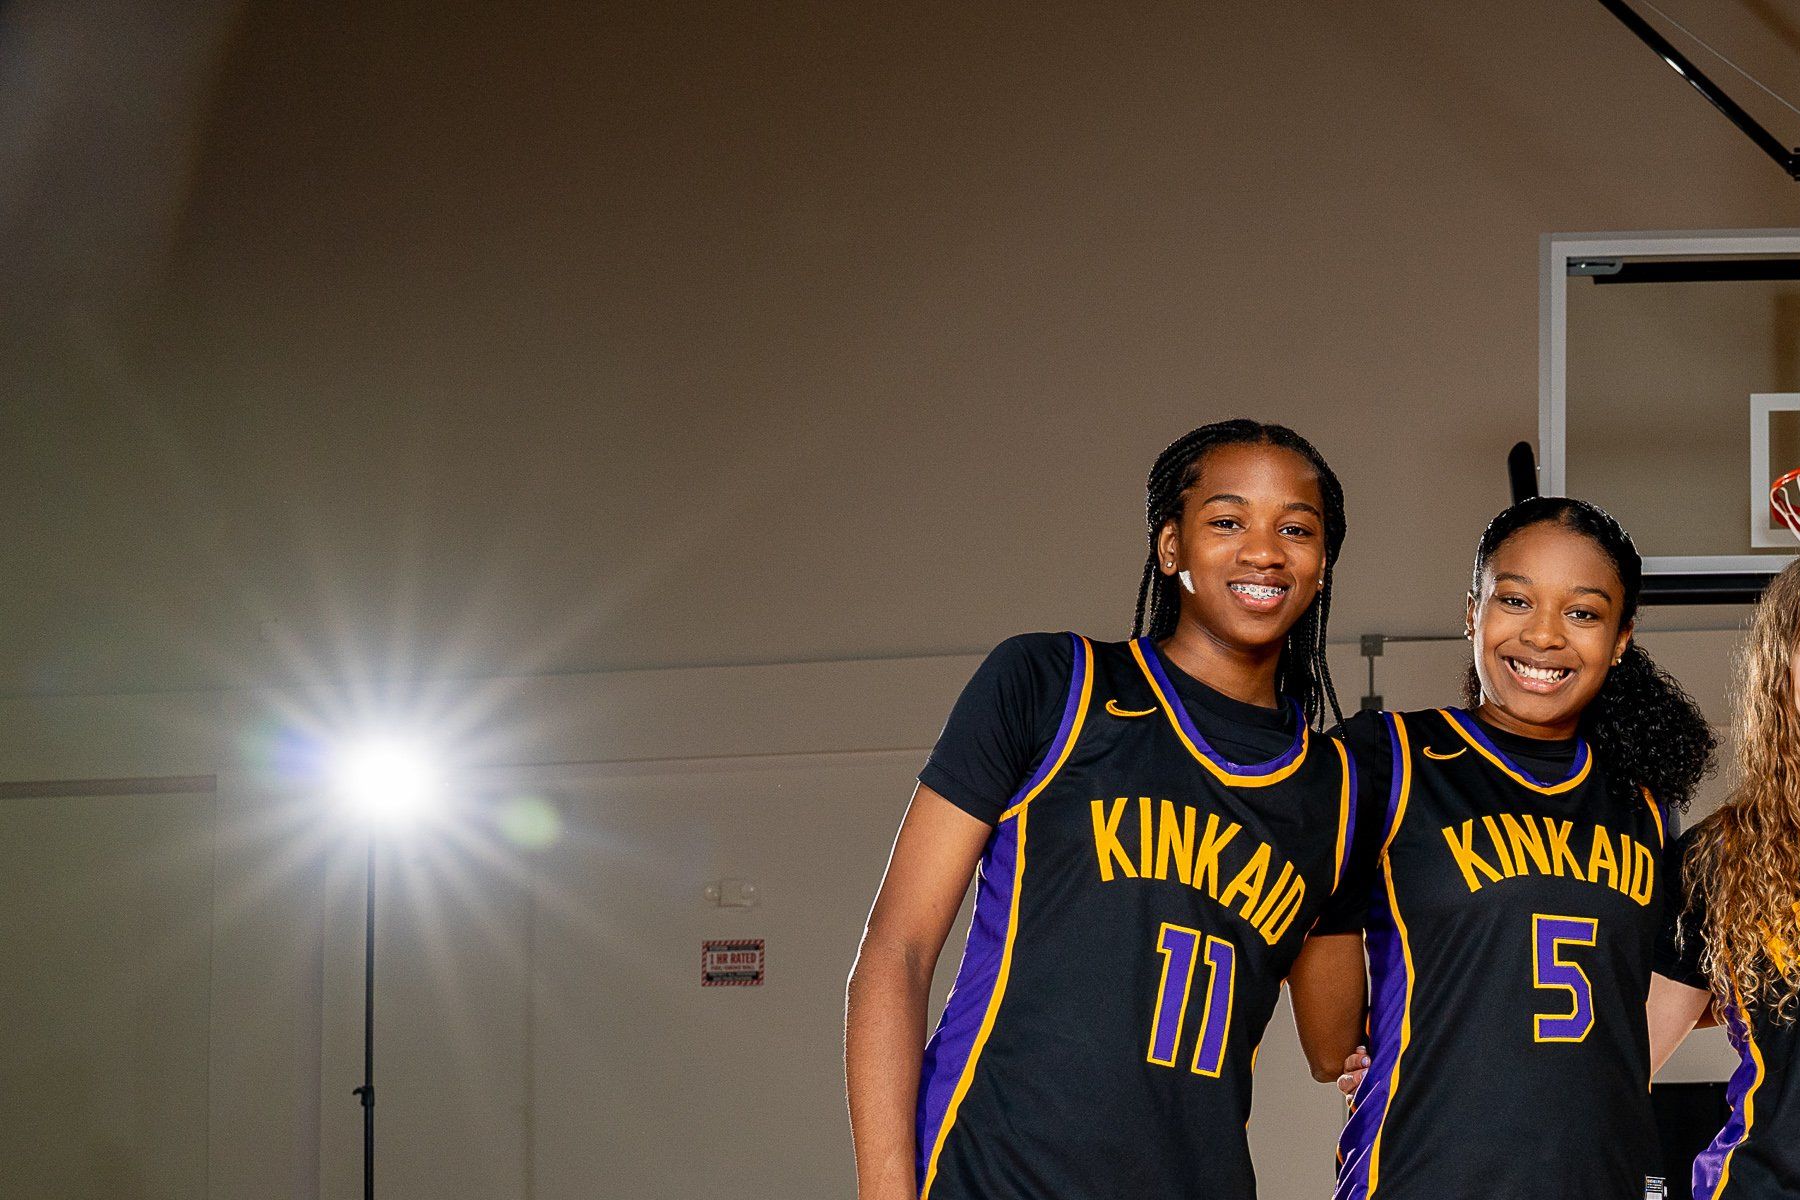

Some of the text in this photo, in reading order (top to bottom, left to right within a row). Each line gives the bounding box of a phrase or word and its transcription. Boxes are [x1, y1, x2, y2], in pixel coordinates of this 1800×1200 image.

[1090, 797, 1306, 946] KINKAID
[1441, 813, 1654, 906] KINKAID
[1147, 922, 1236, 1078] 11
[1532, 913, 1599, 1042] 5
